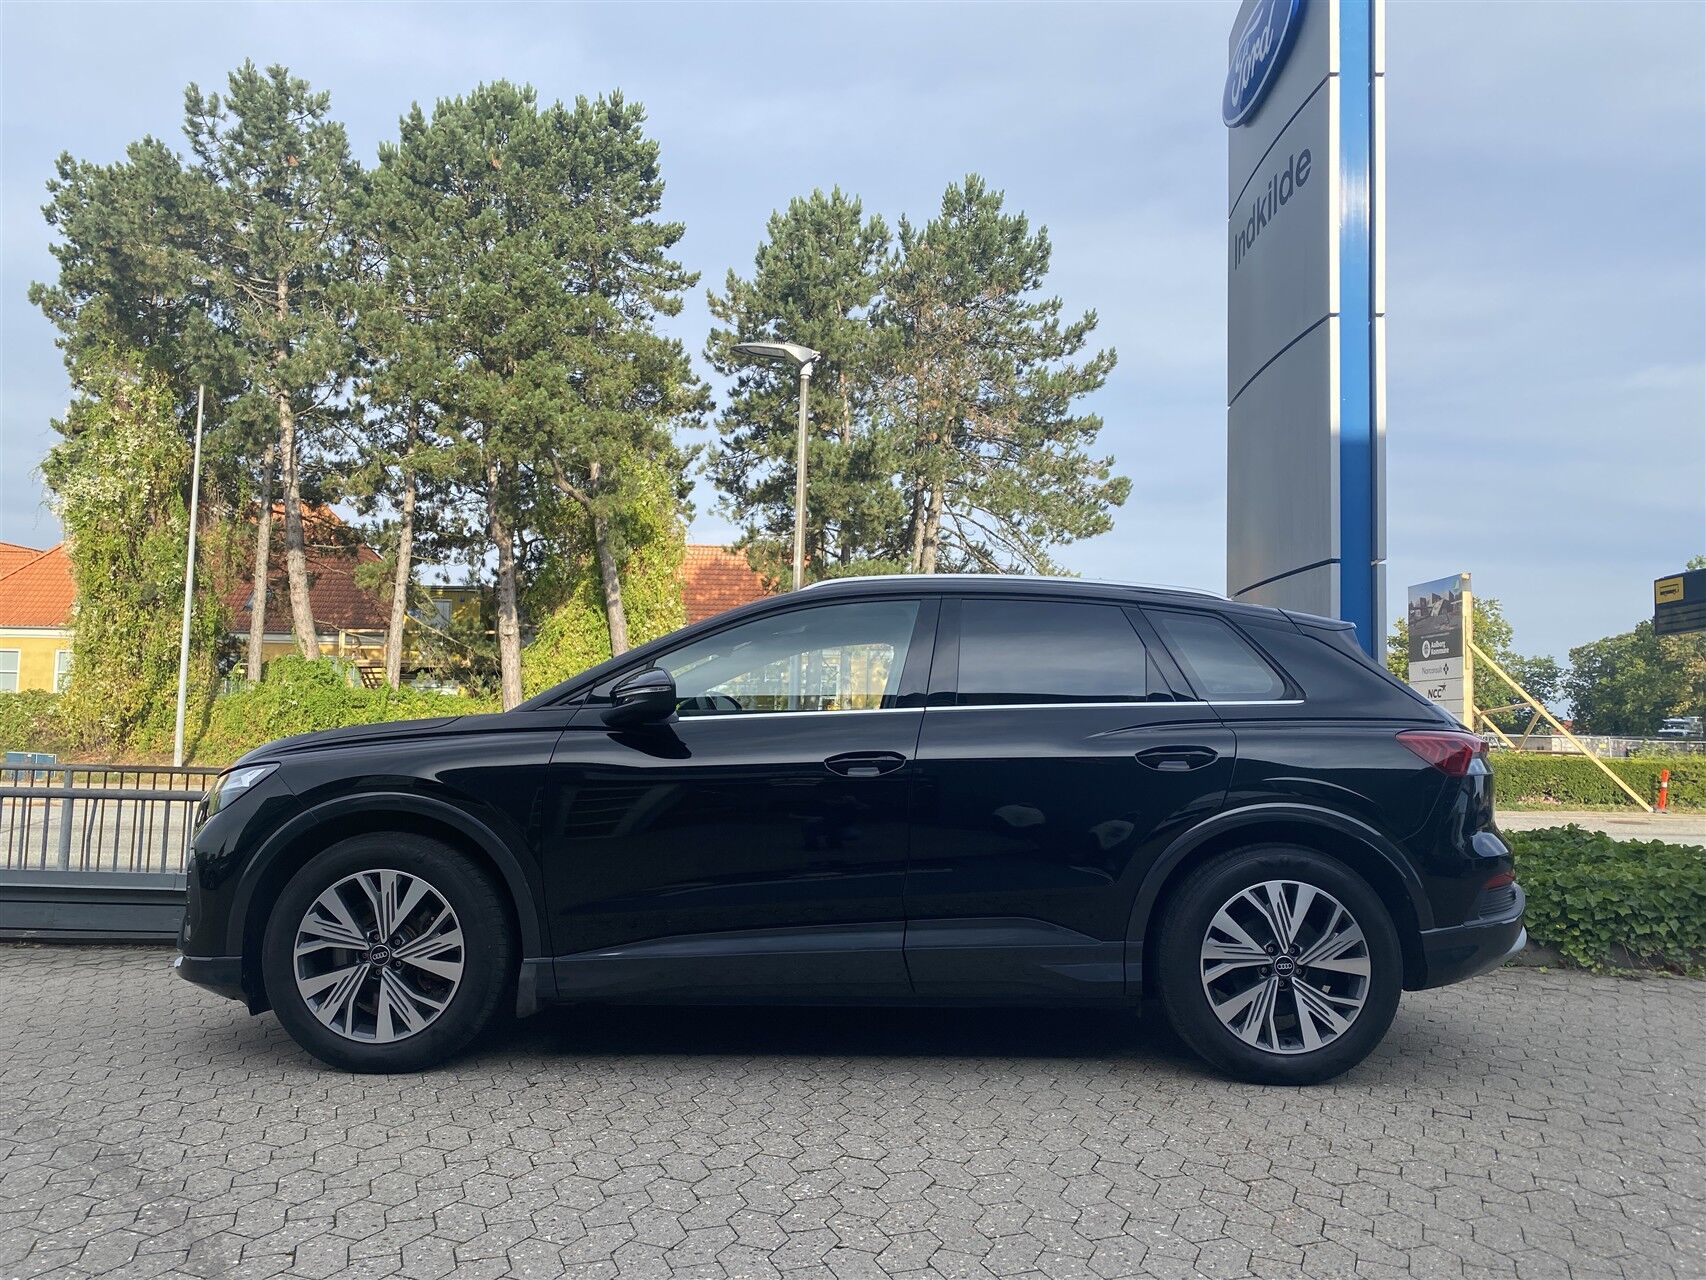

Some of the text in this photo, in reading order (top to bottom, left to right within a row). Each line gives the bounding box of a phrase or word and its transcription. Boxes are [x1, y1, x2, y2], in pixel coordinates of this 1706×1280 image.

[1231, 0, 1275, 107] Ford
[1234, 148, 1312, 270] Indkilde
[1427, 688, 1442, 699] NCC
